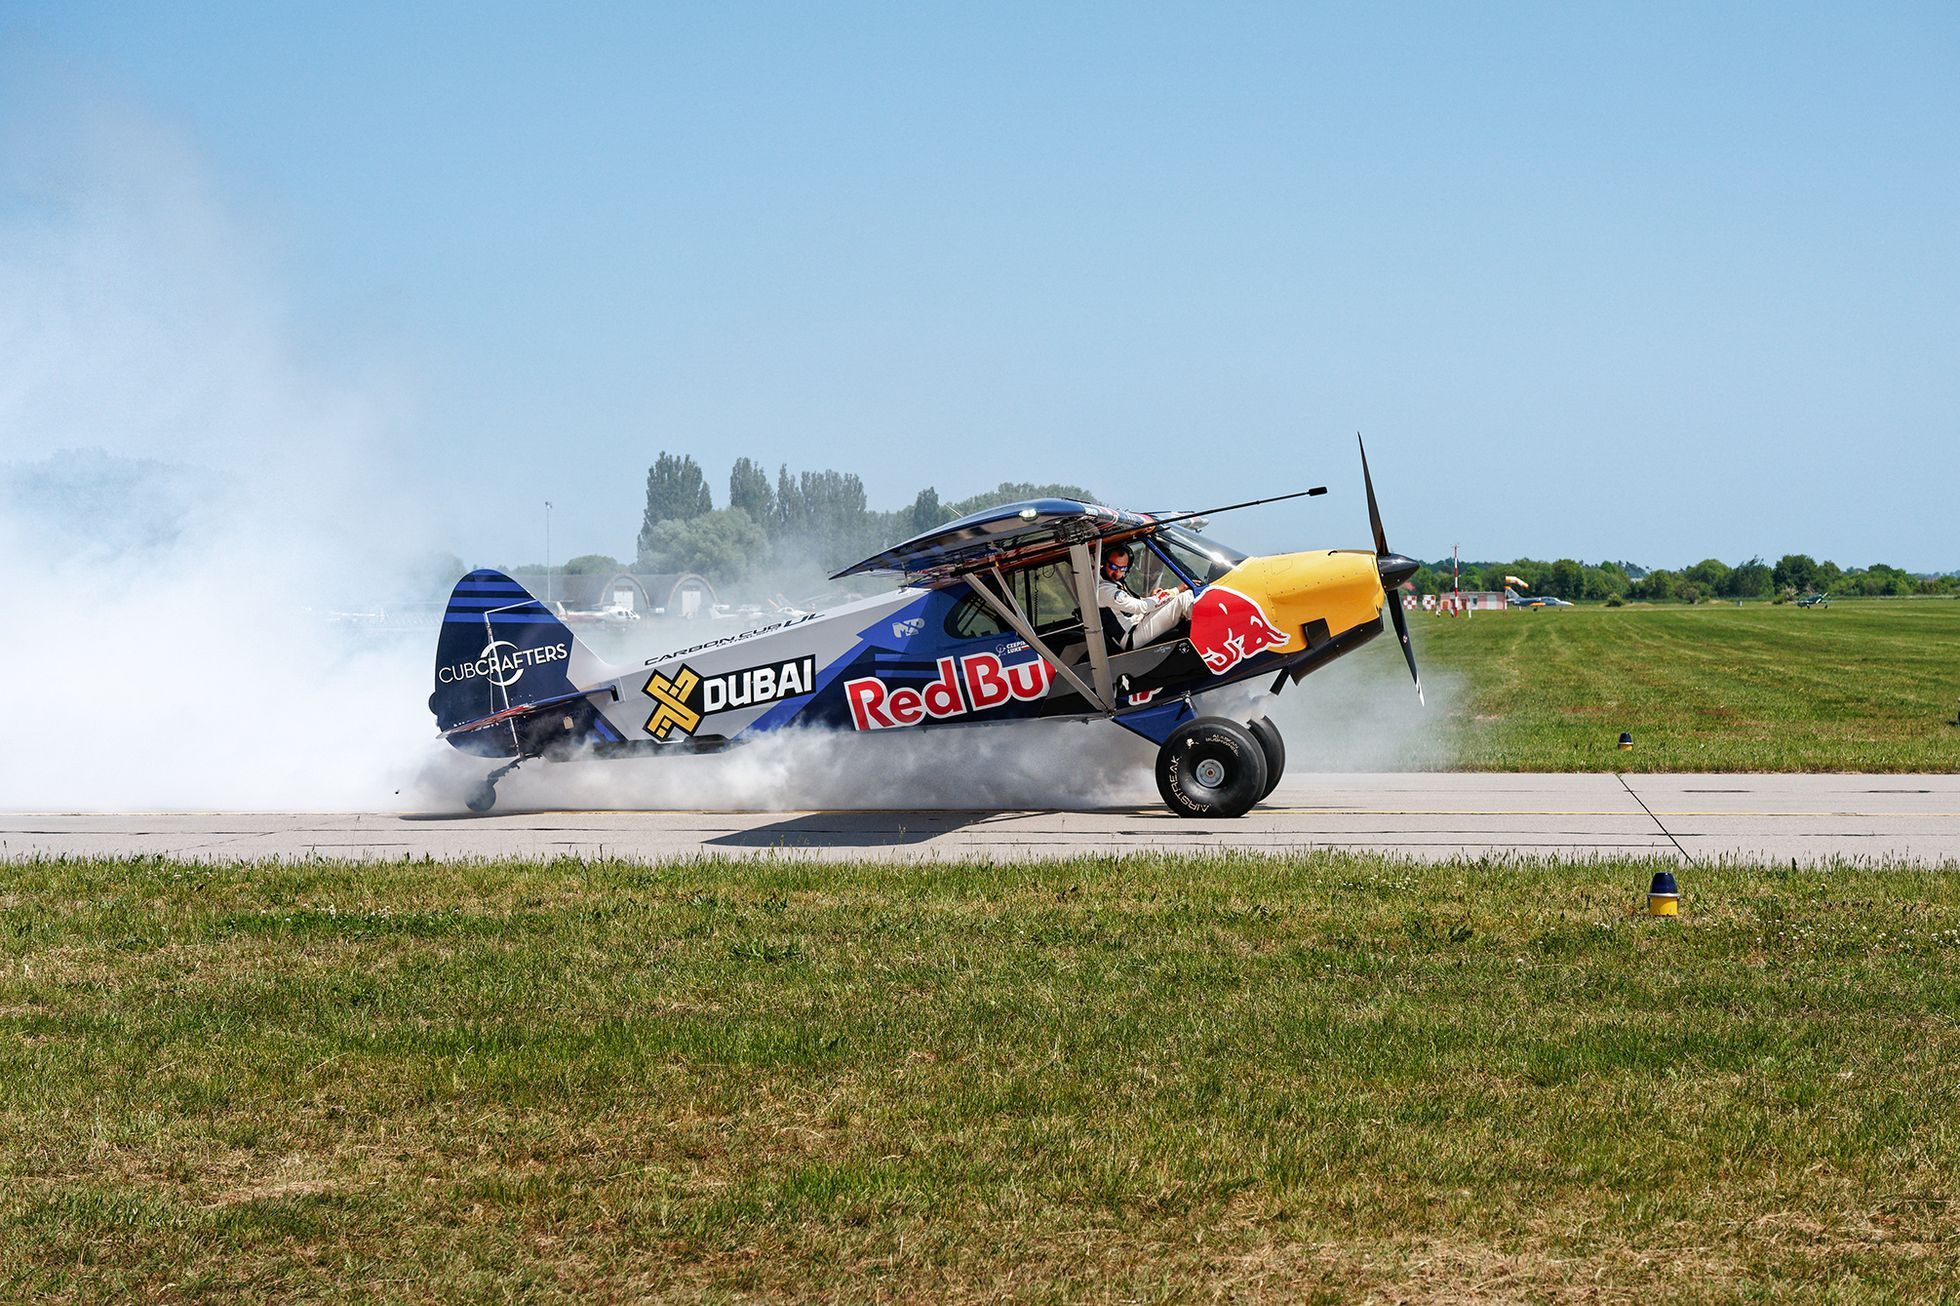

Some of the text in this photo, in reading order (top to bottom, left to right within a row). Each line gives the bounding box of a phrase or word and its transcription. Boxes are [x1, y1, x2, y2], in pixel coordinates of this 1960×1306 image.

[438, 642, 569, 684] CUBCRAFTERS
[644, 636, 736, 667] CARBON
[783, 612, 826, 628] UL
[702, 658, 812, 713] DUBAI
[843, 651, 1057, 731] Red Bu
[1169, 755, 1211, 812] AIRSTREAK
